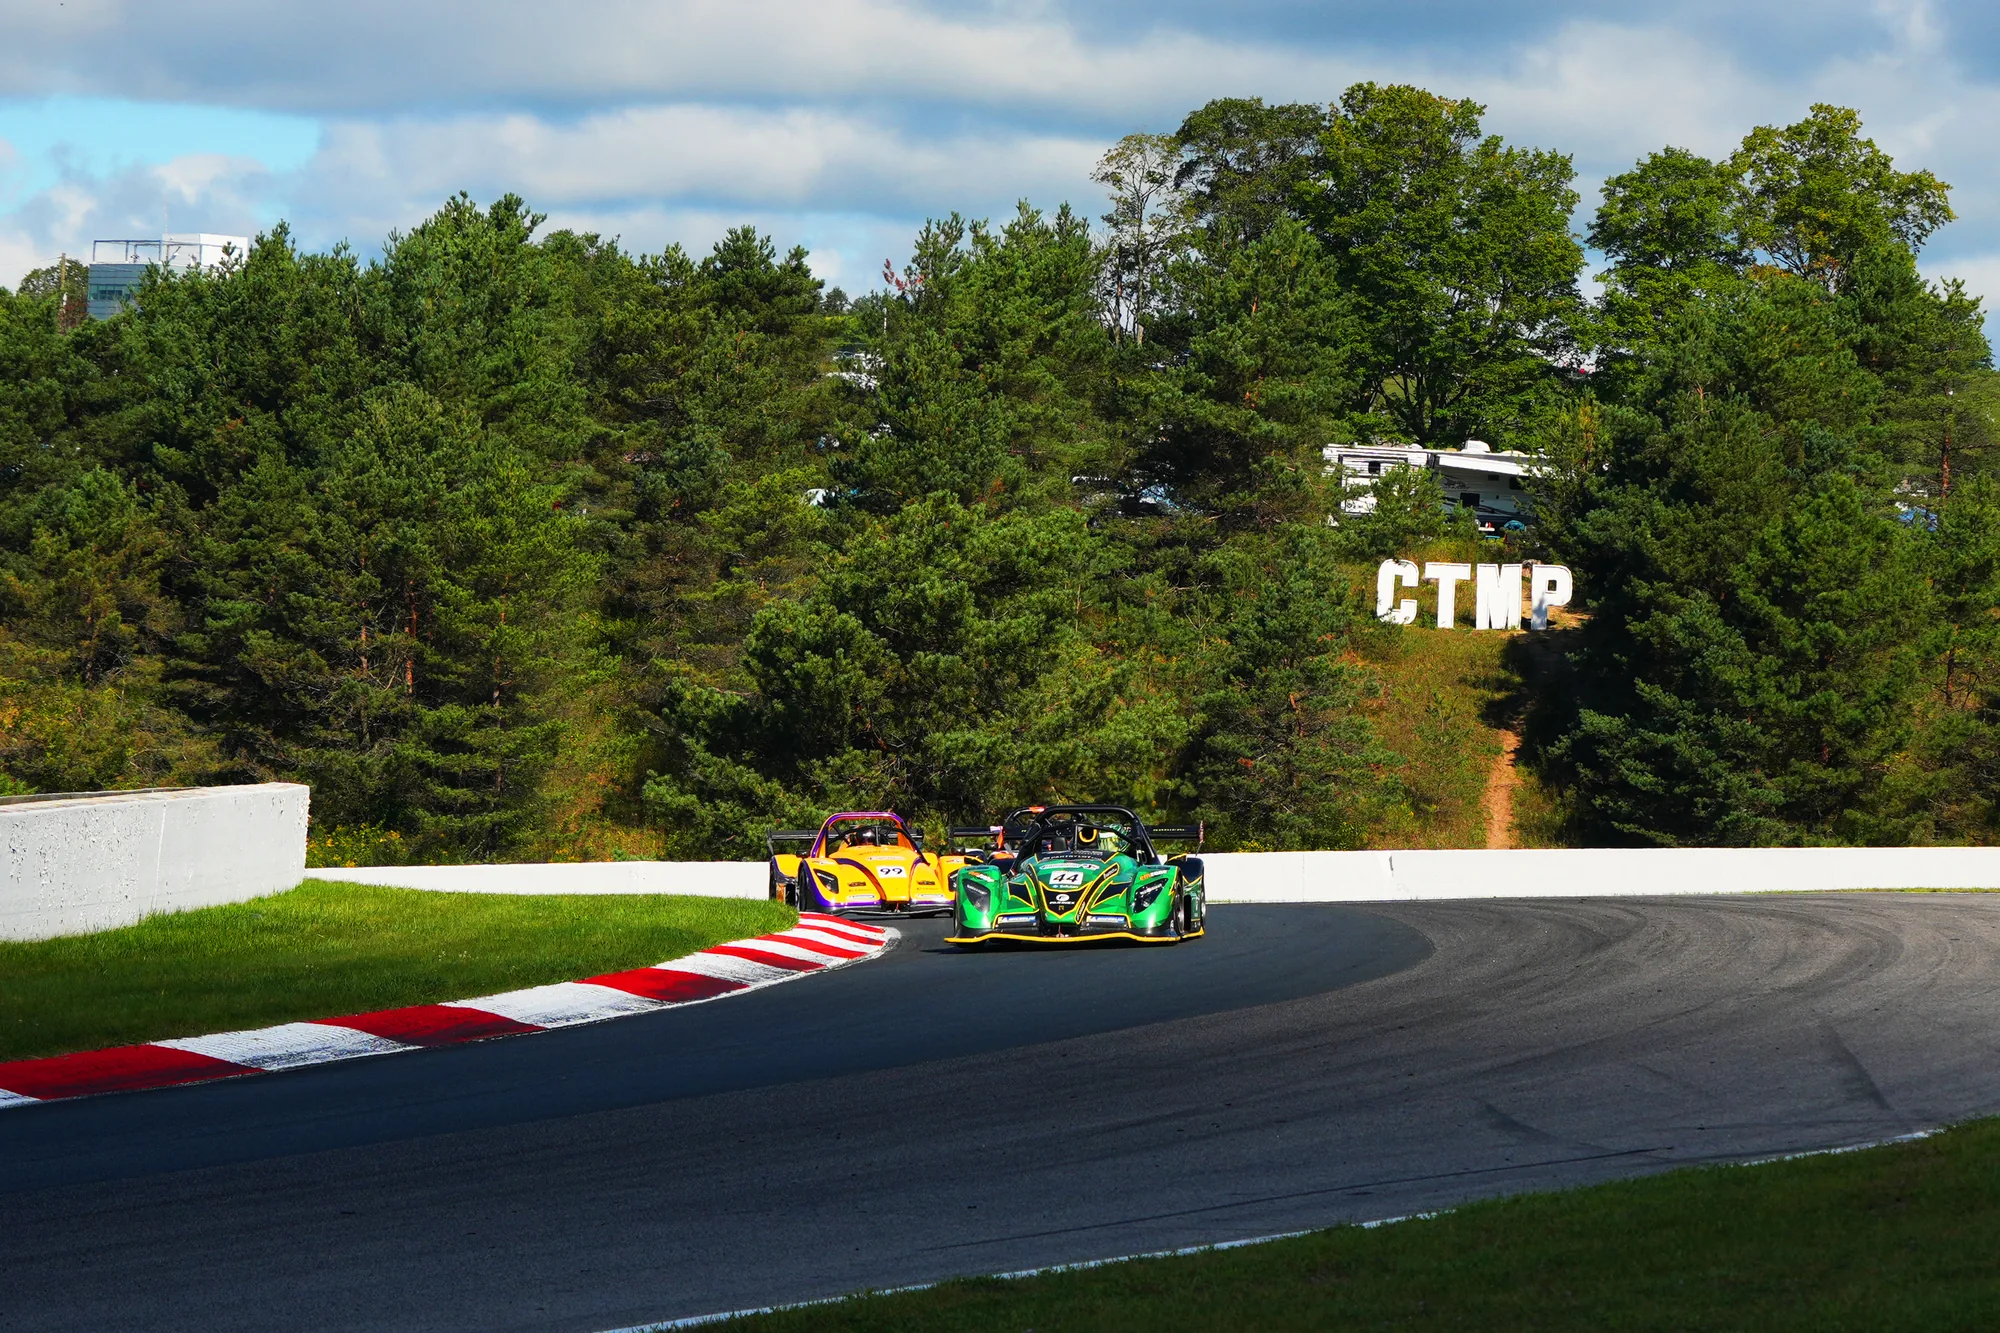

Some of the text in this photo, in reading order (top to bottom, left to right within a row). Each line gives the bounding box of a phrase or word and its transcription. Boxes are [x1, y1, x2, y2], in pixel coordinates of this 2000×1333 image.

[1376, 558, 1573, 630] CTMP
[880, 867, 903, 875] 99
[1053, 873, 1079, 883] 44
